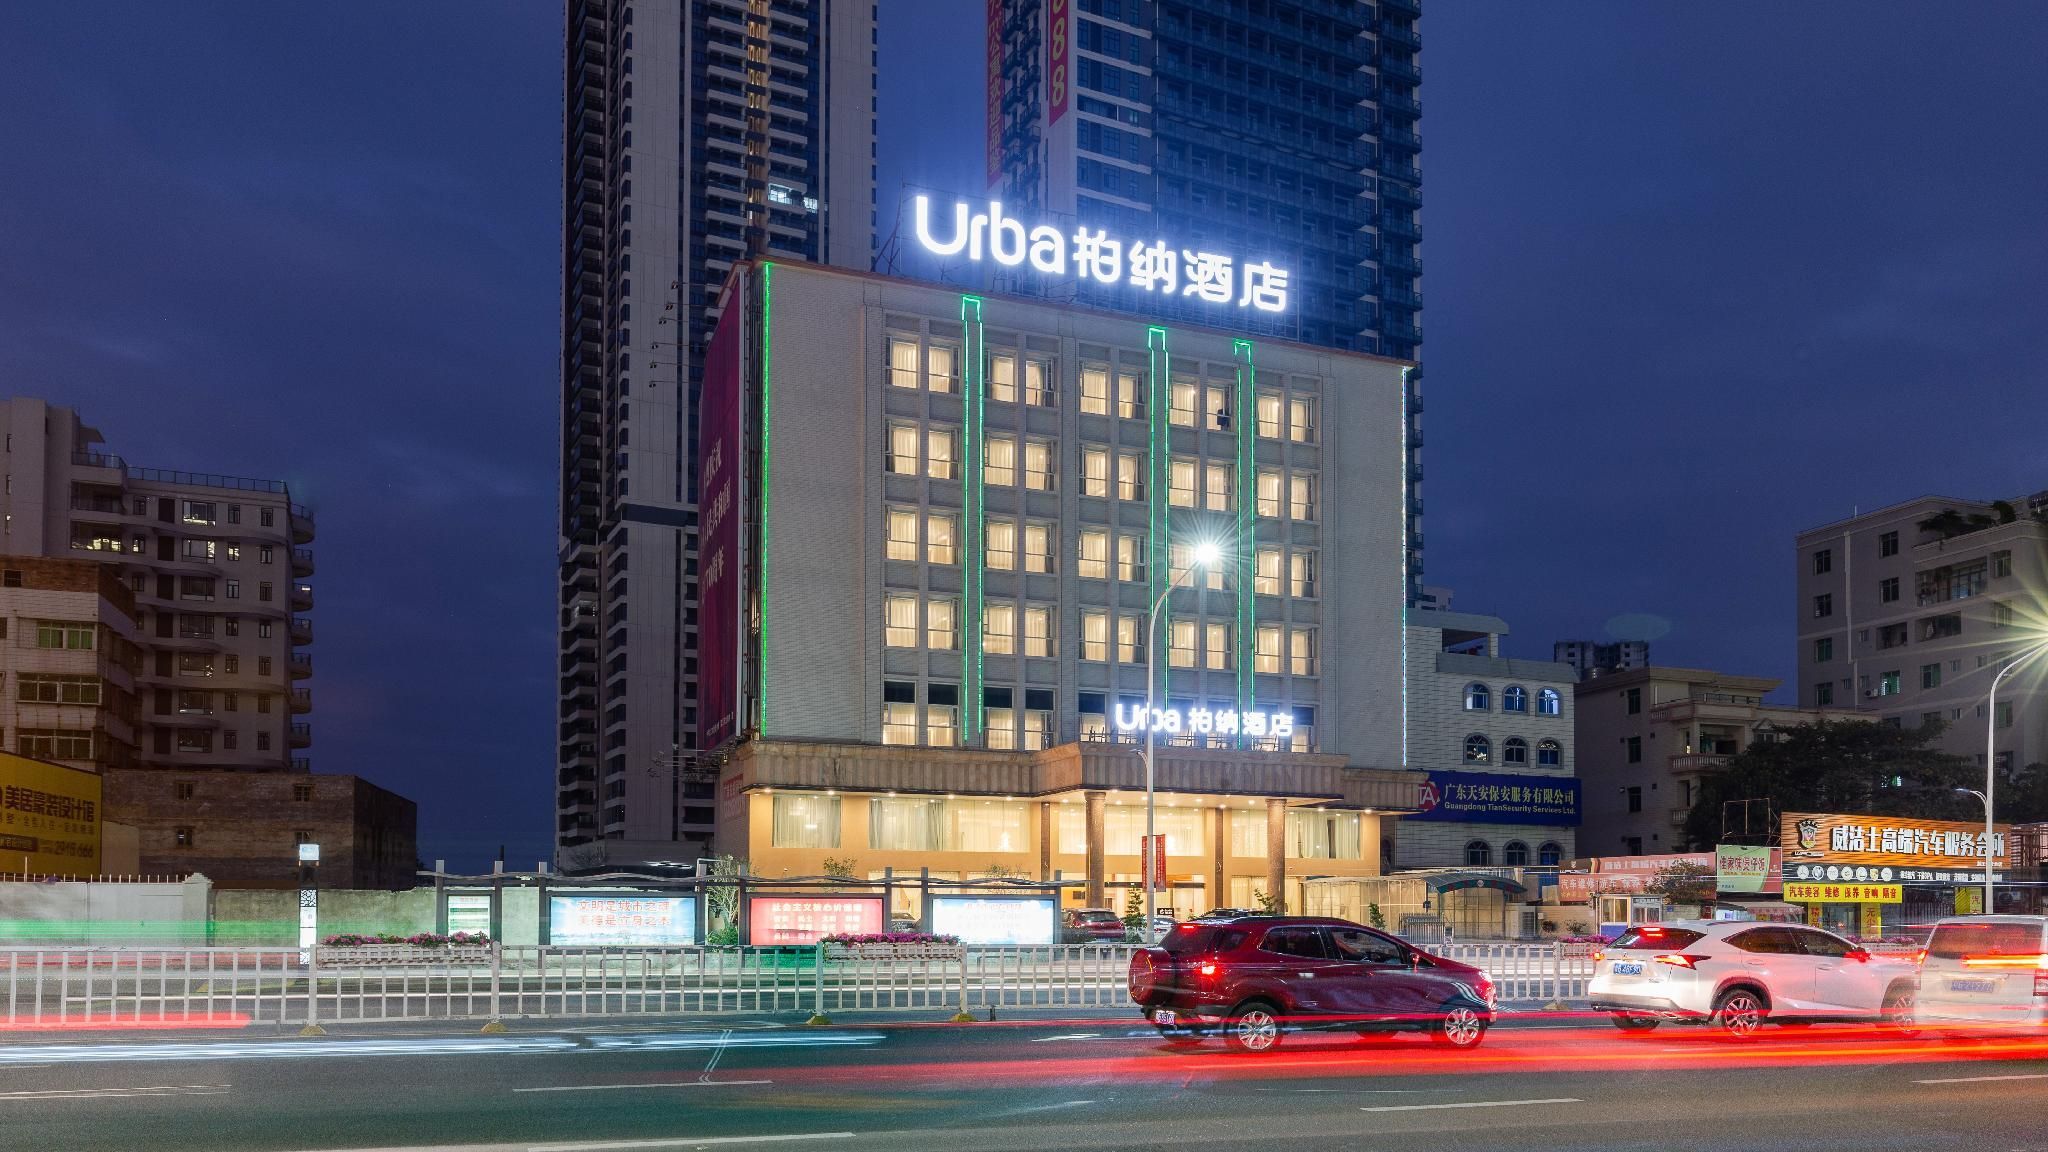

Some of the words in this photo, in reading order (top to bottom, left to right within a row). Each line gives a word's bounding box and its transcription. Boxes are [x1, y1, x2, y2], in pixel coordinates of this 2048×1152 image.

[915, 195, 1066, 275] Urba
[1073, 225, 1290, 313] 柏纳酒店
[1115, 702, 1181, 733] Urba
[1188, 706, 1294, 737] 柏纳酒店
[1444, 783, 1574, 805] 广东天安保安服务有限公司
[1444, 801, 1486, 812] Guangdong
[1488, 803, 1532, 814] TianSecurity
[1533, 805, 1562, 814] Services
[1563, 807, 1576, 815] Ltd.
[1789, 886, 1820, 898] 汽车美容
[1825, 886, 1840, 898] 维修
[1844, 887, 1860, 899] 保养
[1864, 888, 1879, 899] 音响
[1882, 888, 1897, 899] 隔音
